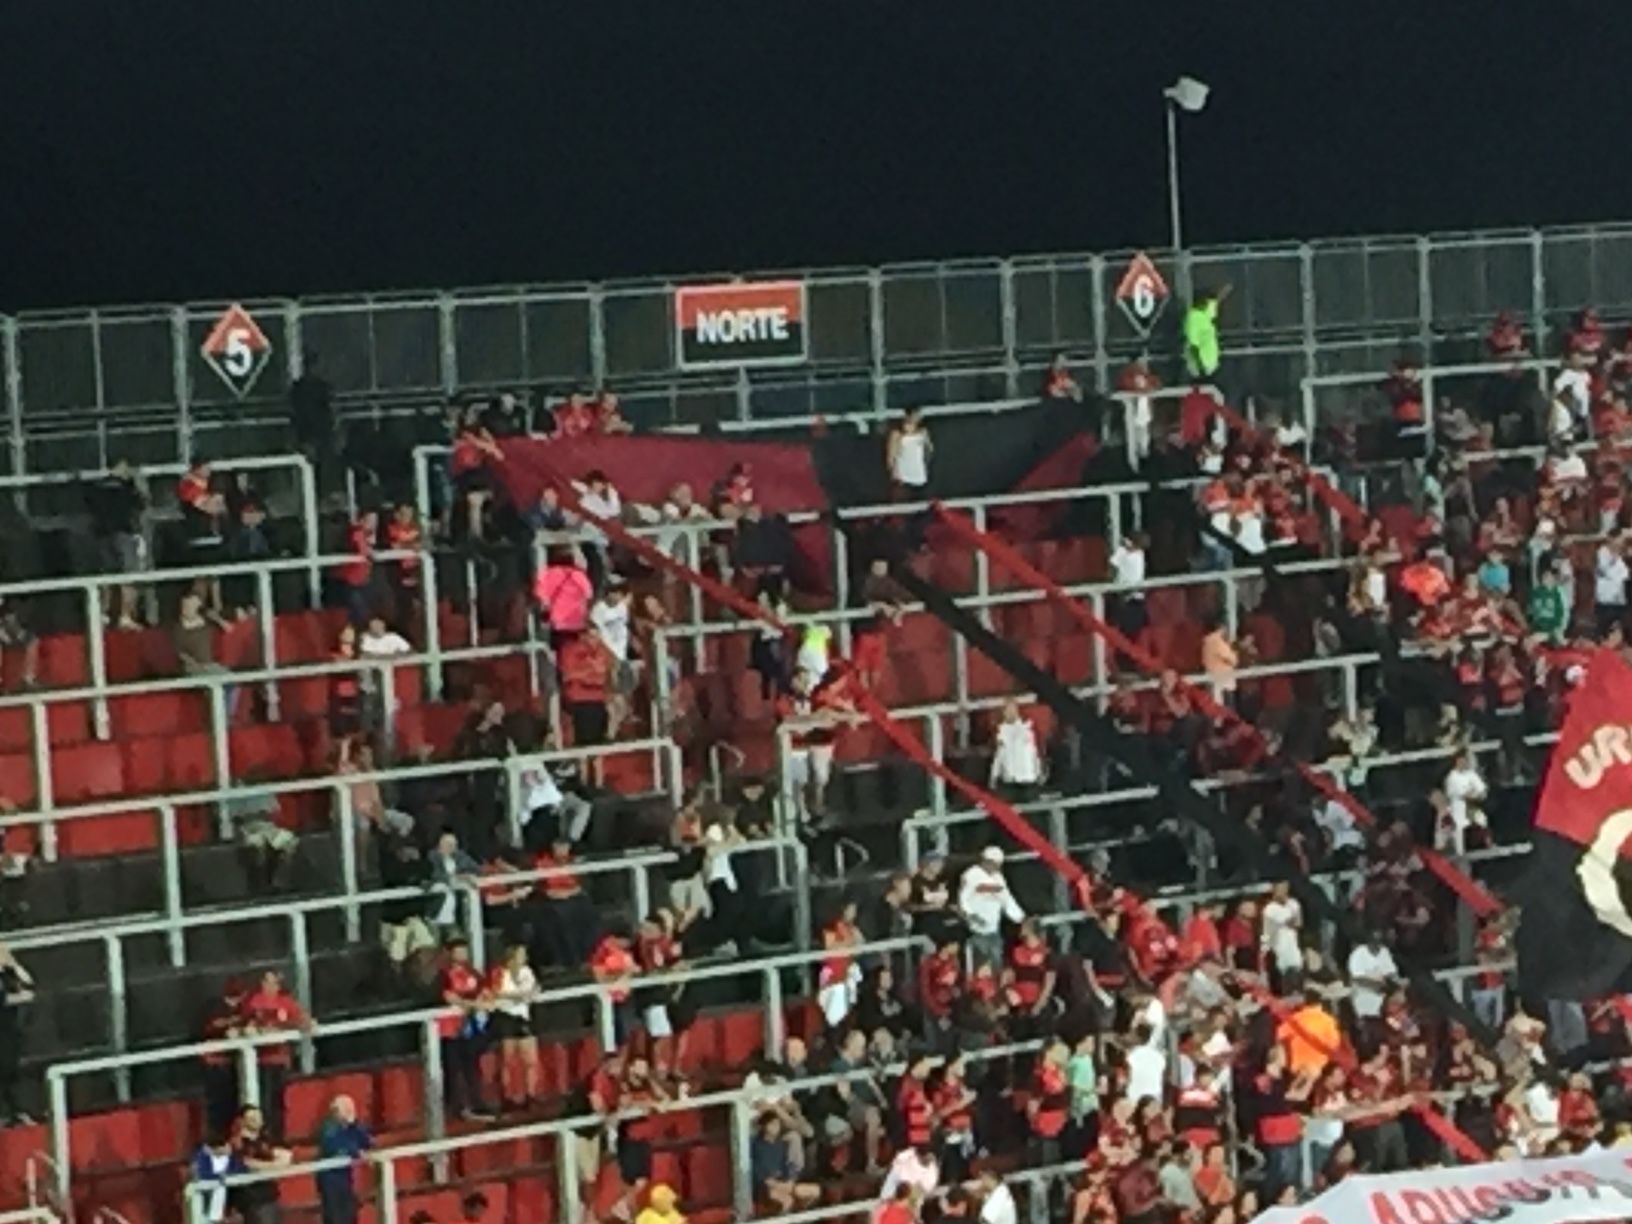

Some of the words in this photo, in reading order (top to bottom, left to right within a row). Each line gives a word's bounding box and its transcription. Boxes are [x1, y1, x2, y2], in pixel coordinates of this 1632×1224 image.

[1134, 274, 1155, 318] 6
[696, 306, 790, 343] NORTE
[225, 328, 252, 375] 5
